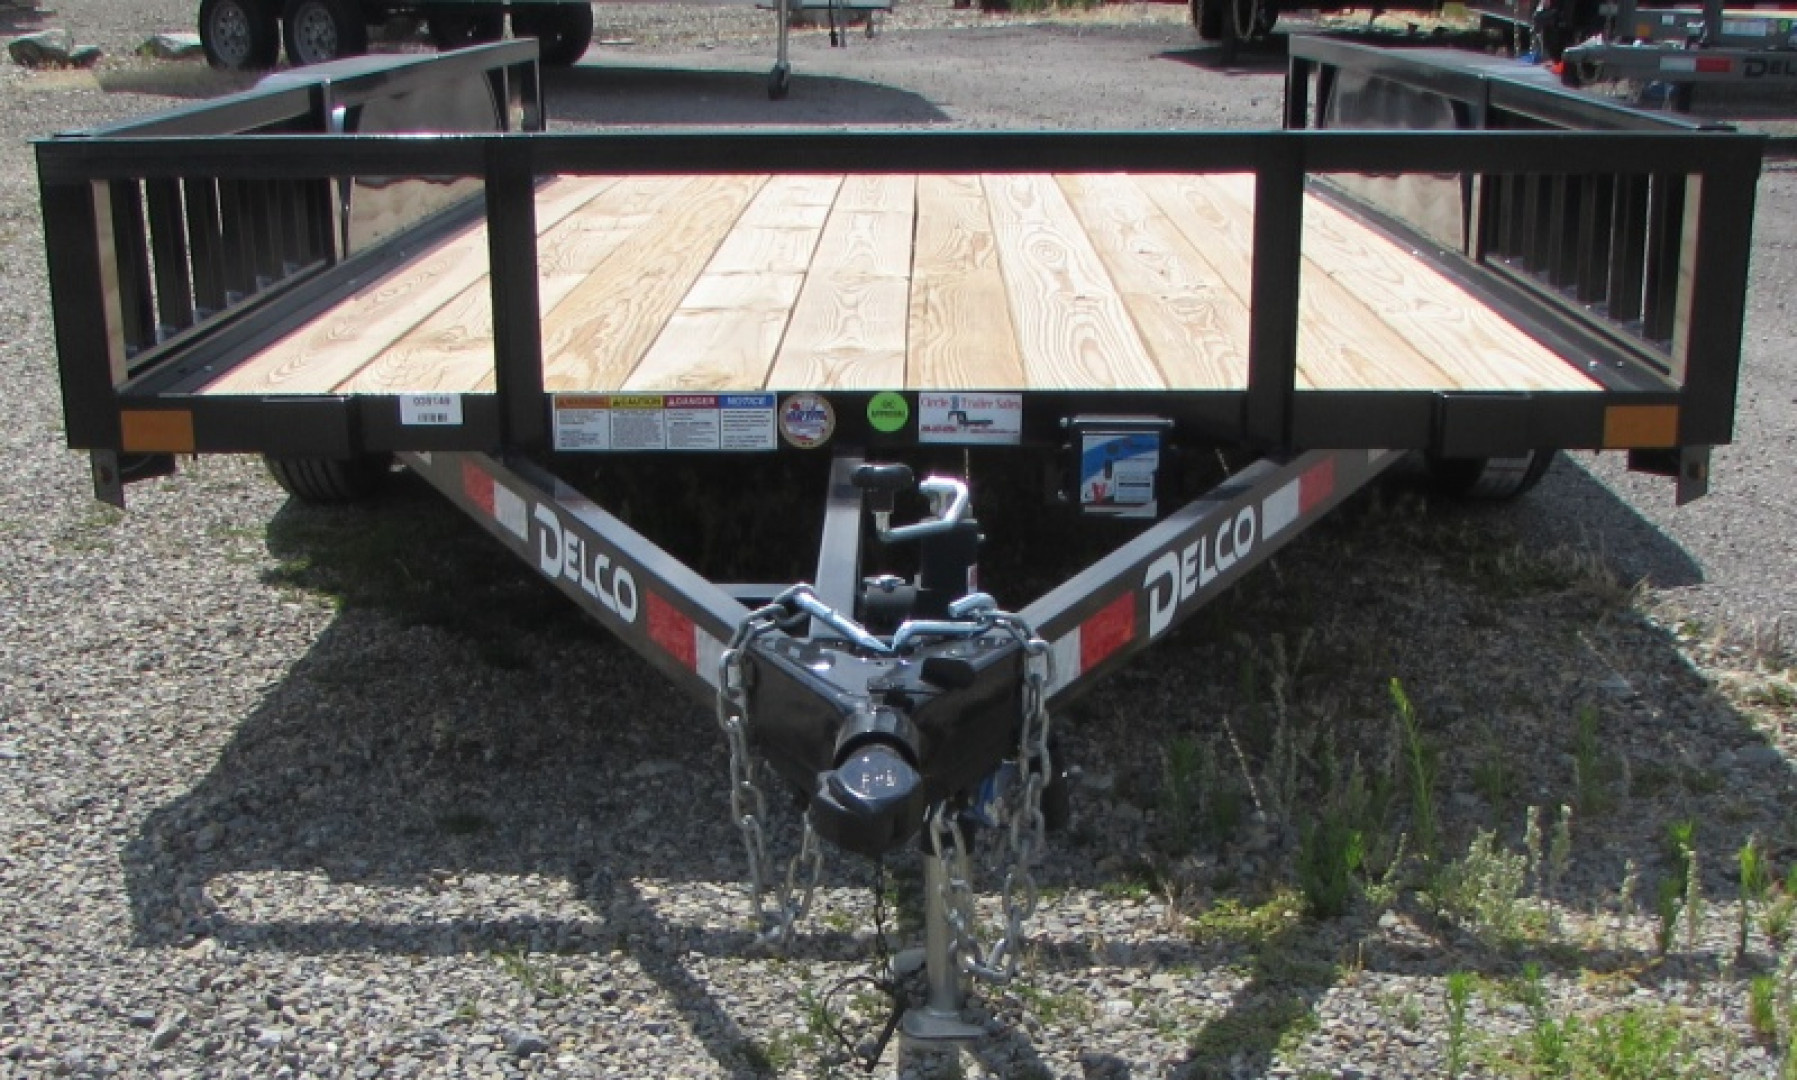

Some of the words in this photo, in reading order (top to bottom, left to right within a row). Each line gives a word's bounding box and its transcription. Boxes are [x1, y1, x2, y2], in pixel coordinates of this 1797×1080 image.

[675, 396, 716, 405] DANGER
[727, 396, 766, 405] NOTICE
[535, 502, 637, 623] DELCO
[1143, 504, 1256, 638] DELCO
